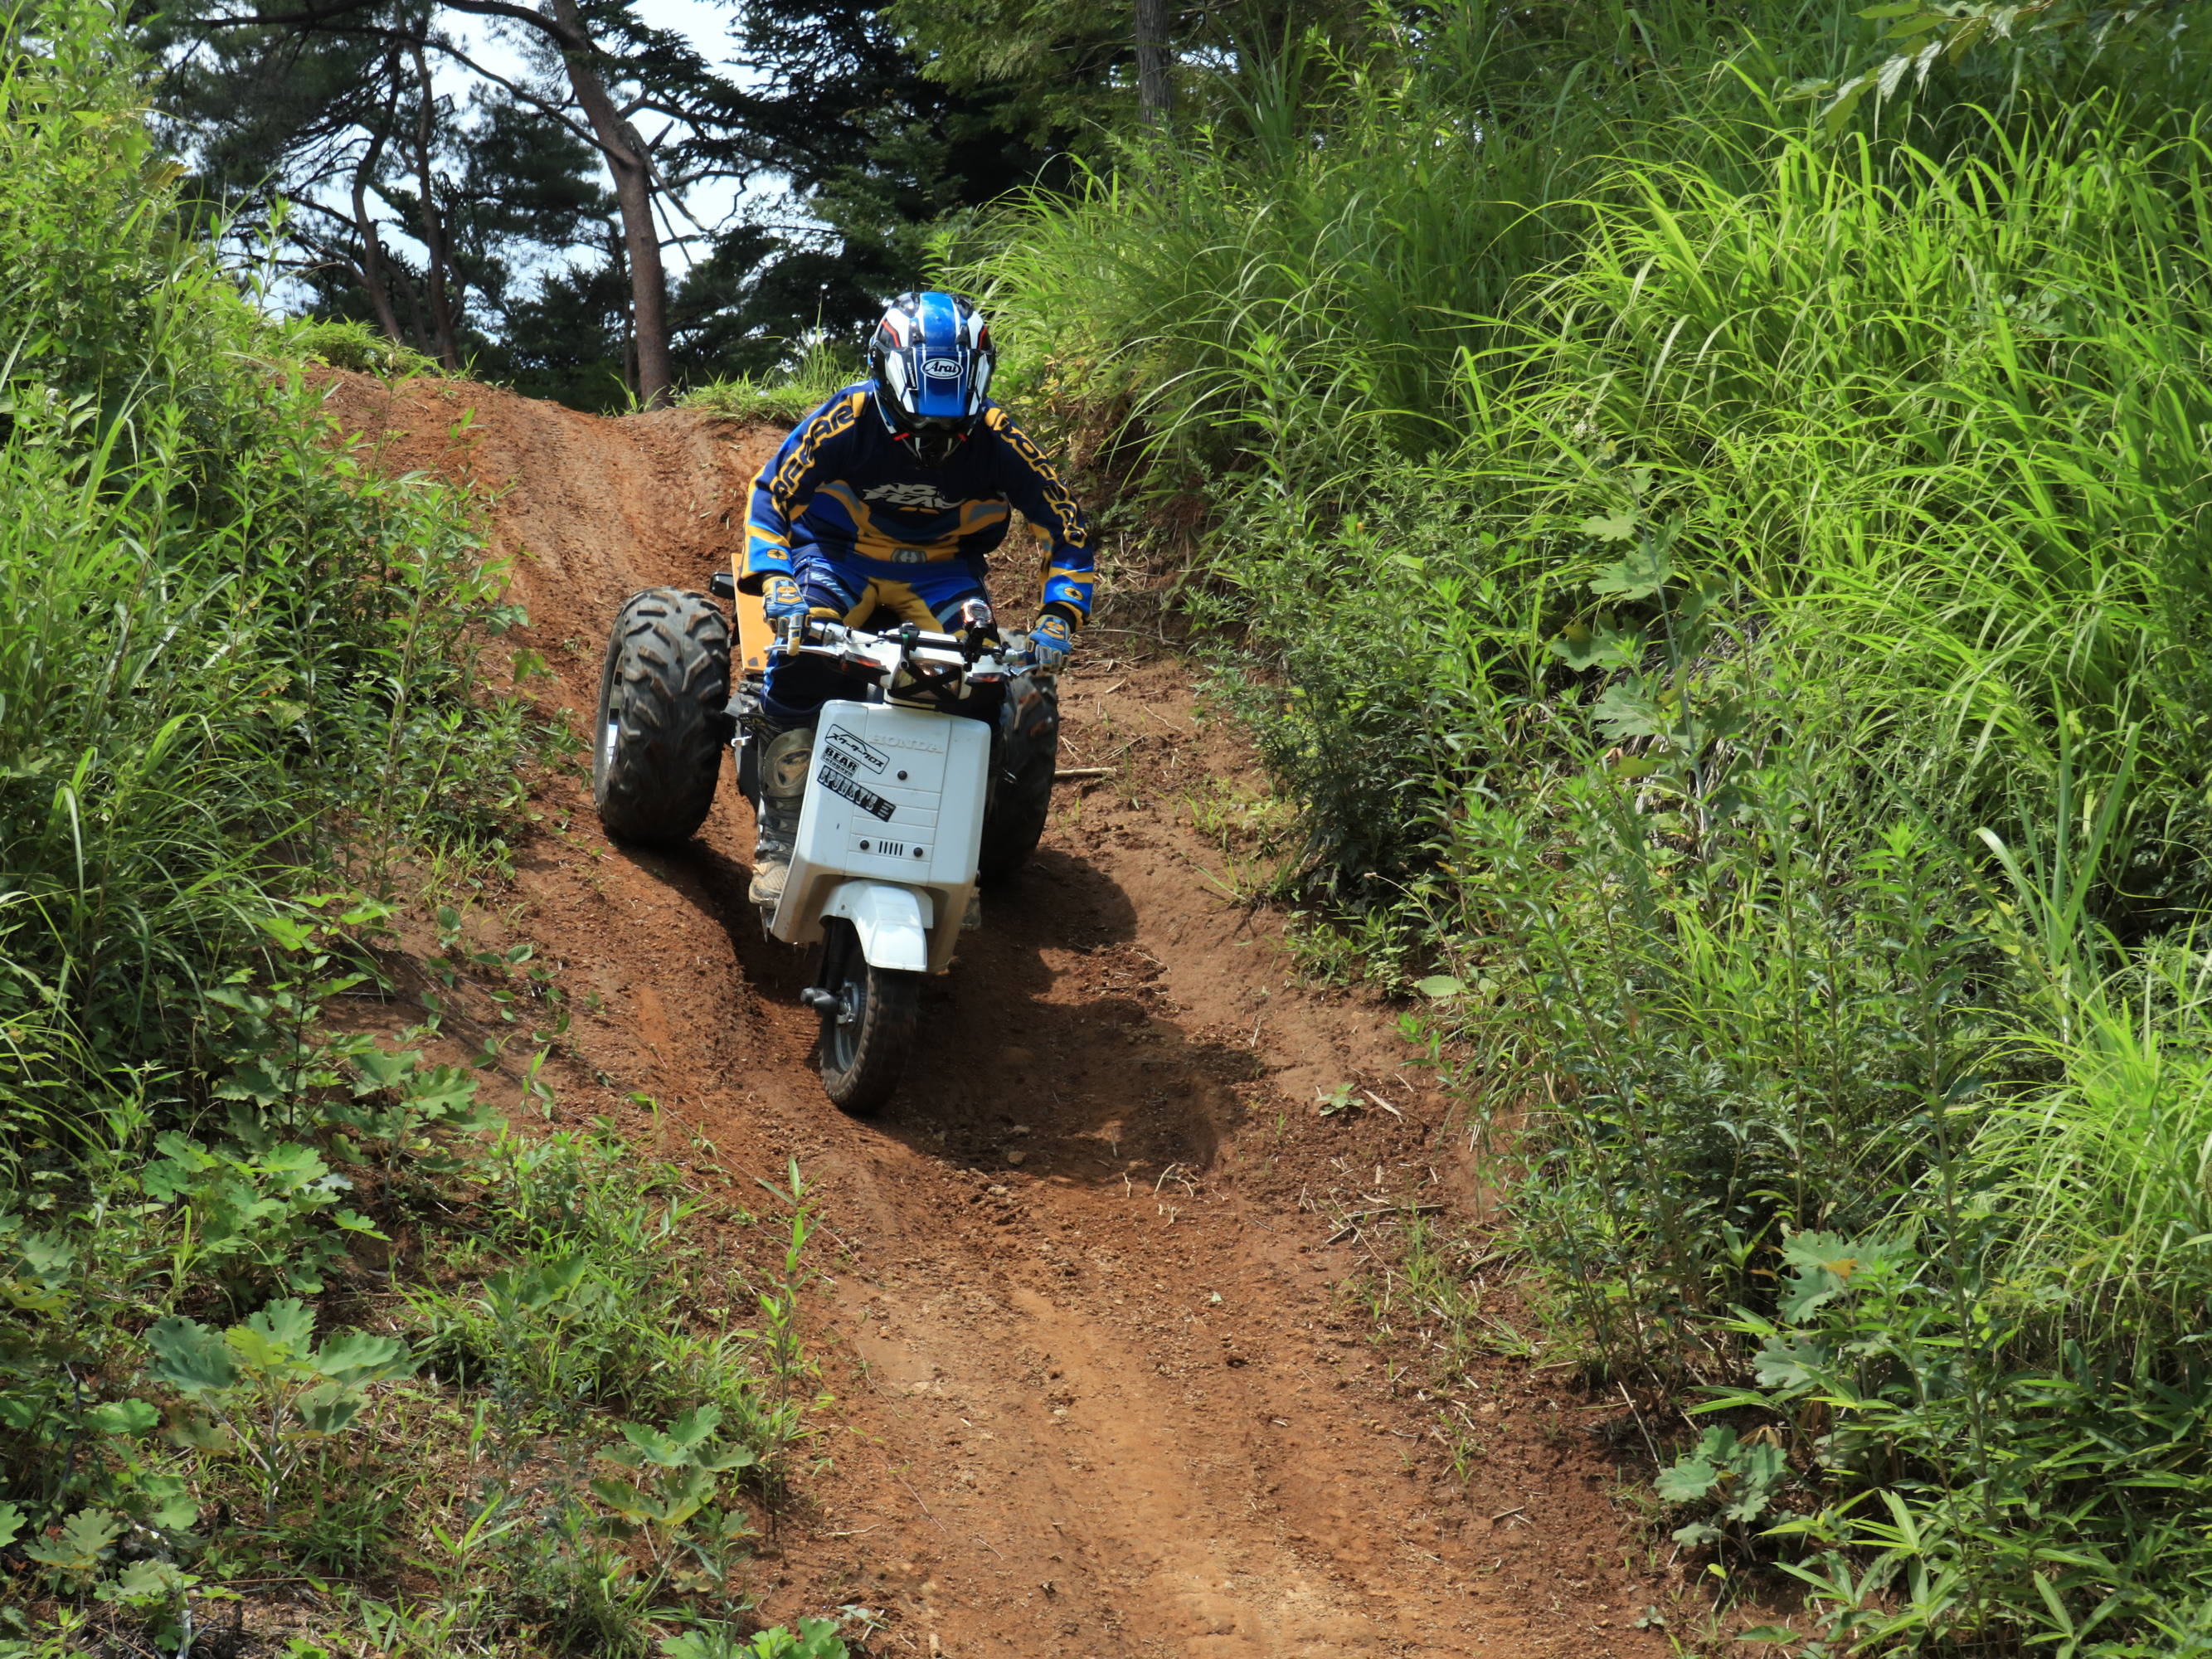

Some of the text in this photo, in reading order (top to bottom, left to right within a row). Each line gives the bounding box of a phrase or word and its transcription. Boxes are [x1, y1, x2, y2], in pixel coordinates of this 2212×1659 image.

[925, 360, 957, 372] Arai
[871, 483, 937, 496] NO
[828, 732, 885, 767] スクータークロス
[868, 734, 944, 754] HONDA
[824, 747, 858, 771] BEAR
